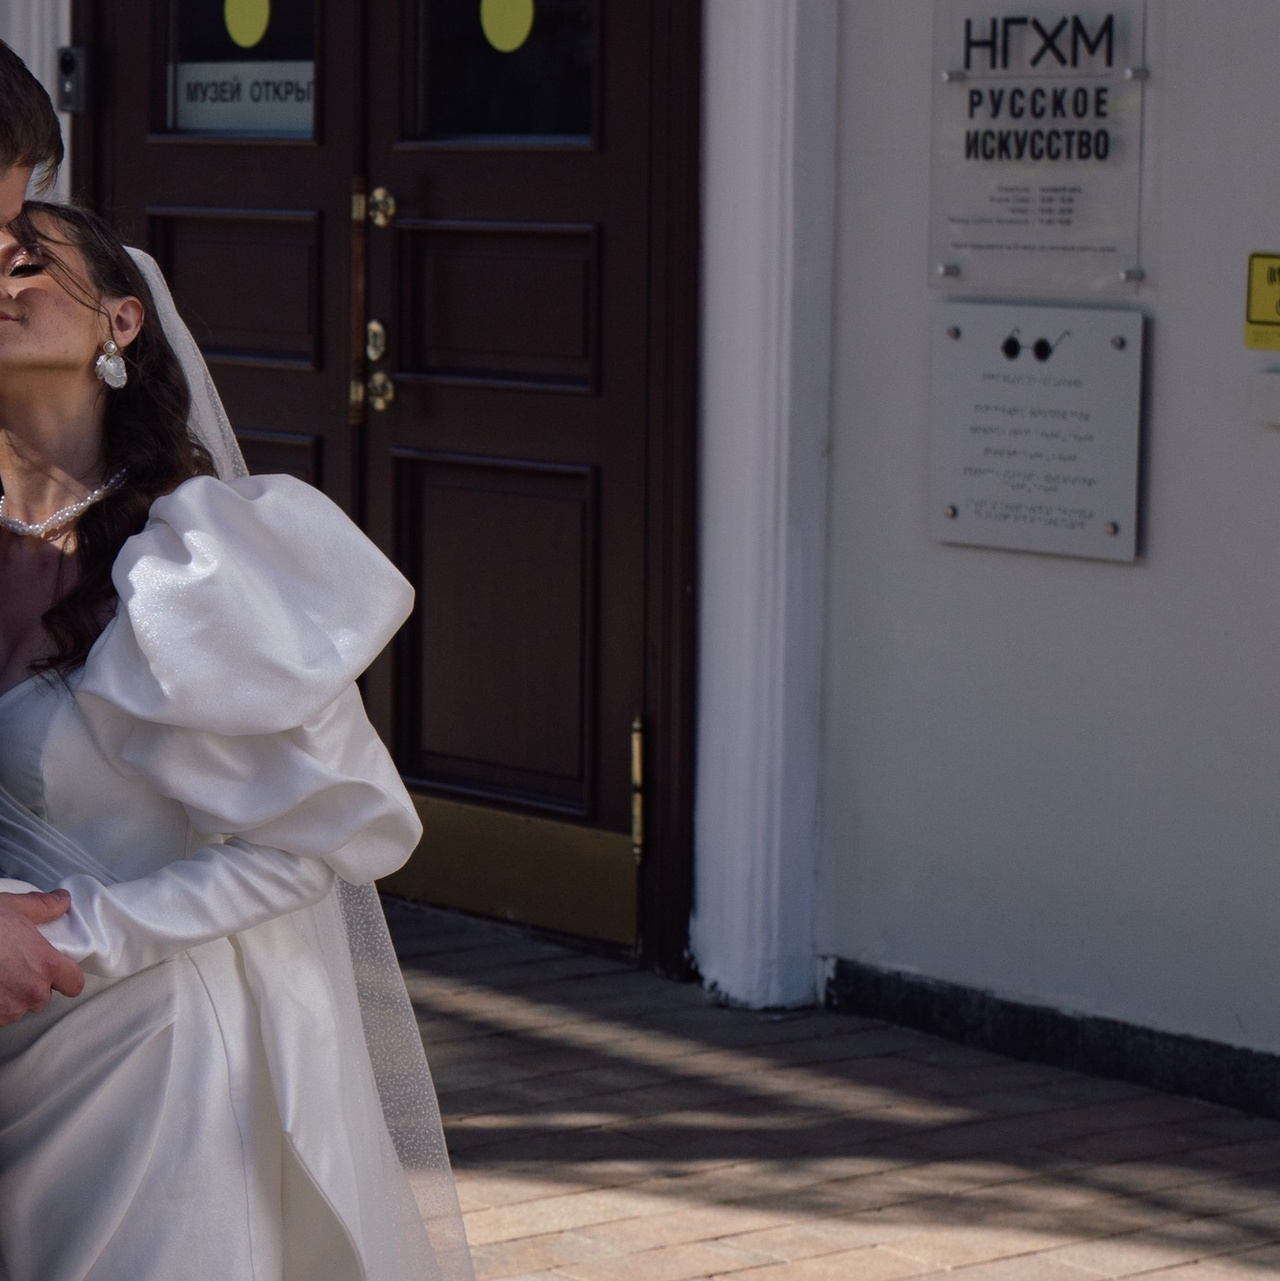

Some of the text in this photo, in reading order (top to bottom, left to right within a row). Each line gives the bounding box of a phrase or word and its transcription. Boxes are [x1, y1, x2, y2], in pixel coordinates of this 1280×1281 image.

[964, 13, 1114, 70] НГХМ
[185, 76, 242, 103] МУЗЕЙ
[968, 87, 1109, 119] РУССКОЕ
[965, 129, 1110, 160] ИСКУССТВО
